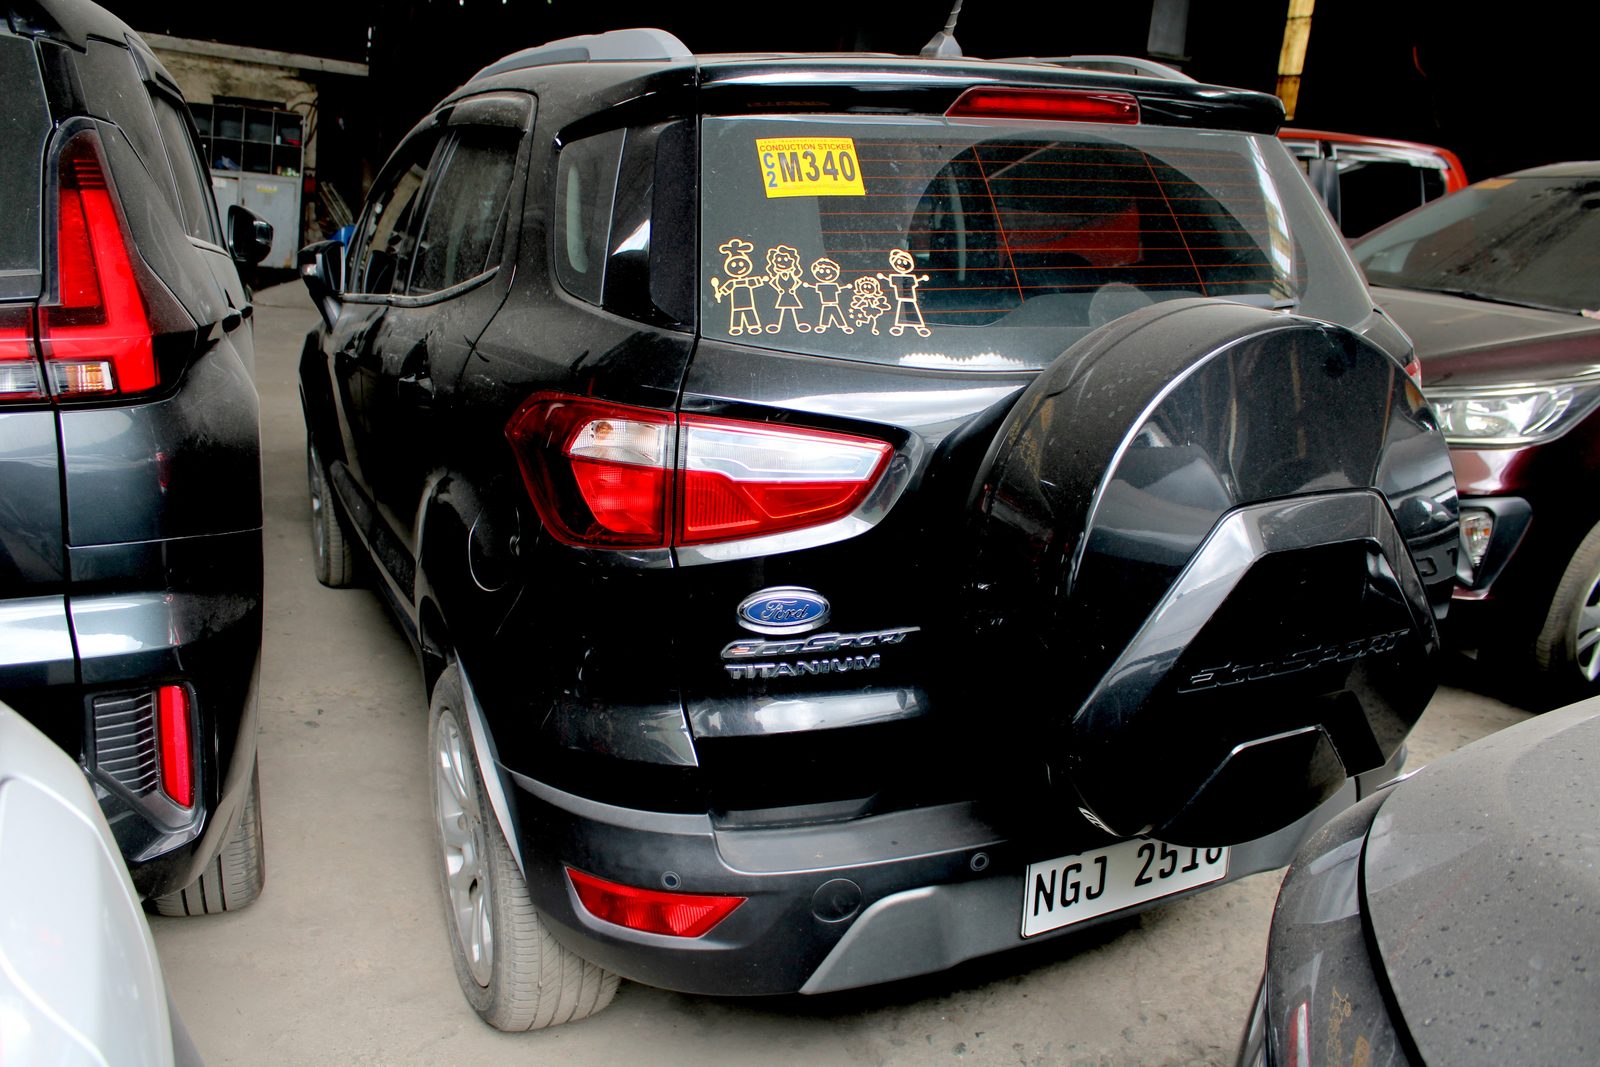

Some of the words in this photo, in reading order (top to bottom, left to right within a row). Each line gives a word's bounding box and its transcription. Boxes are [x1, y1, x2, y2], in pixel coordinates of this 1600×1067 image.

[778, 151, 856, 182] M340
[760, 600, 809, 620] Ford
[725, 654, 881, 679] TITANIUM
[1033, 855, 1108, 916] NGJ
